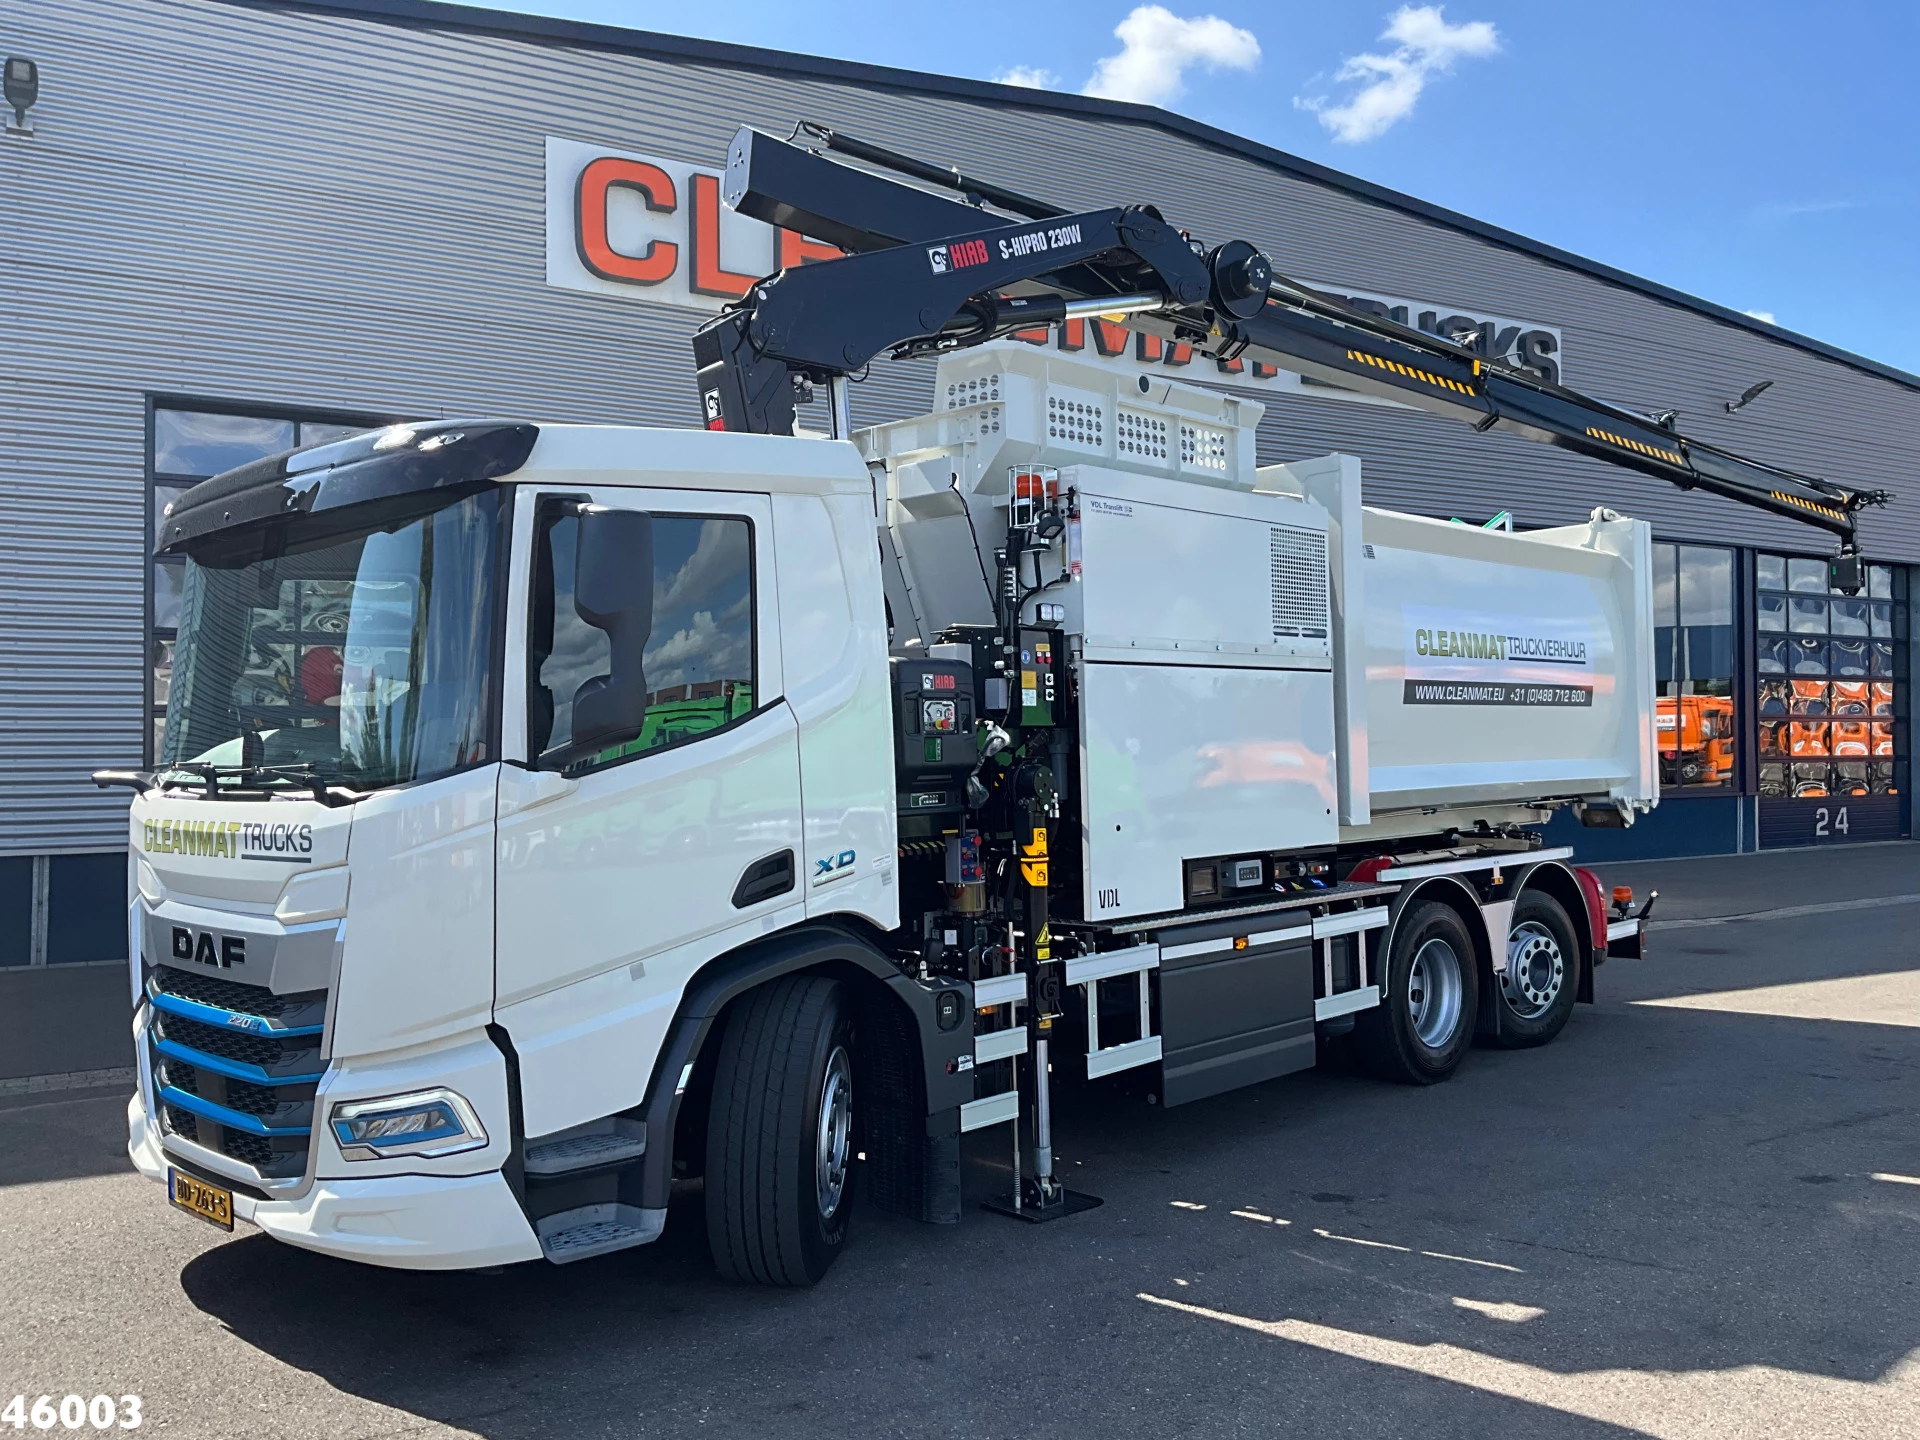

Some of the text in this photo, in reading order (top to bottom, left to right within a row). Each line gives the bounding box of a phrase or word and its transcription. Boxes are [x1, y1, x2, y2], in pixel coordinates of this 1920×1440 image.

[949, 224, 1082, 268] HIAB S-HIPRO 230W
[1090, 501, 1102, 509] VDL
[1415, 628, 1586, 660] CLEANMAT TRUCKVERHUUR
[934, 674, 955, 689] HIAB
[1415, 685, 1586, 703] WWW.CLEANMAT.EU +31 (0)488 712 600
[1815, 806, 1849, 836] 24
[144, 819, 313, 858] CLEANMAT TRUCKS
[813, 848, 856, 876] XD
[1098, 888, 1121, 908] VDL
[172, 925, 247, 969] DAF
